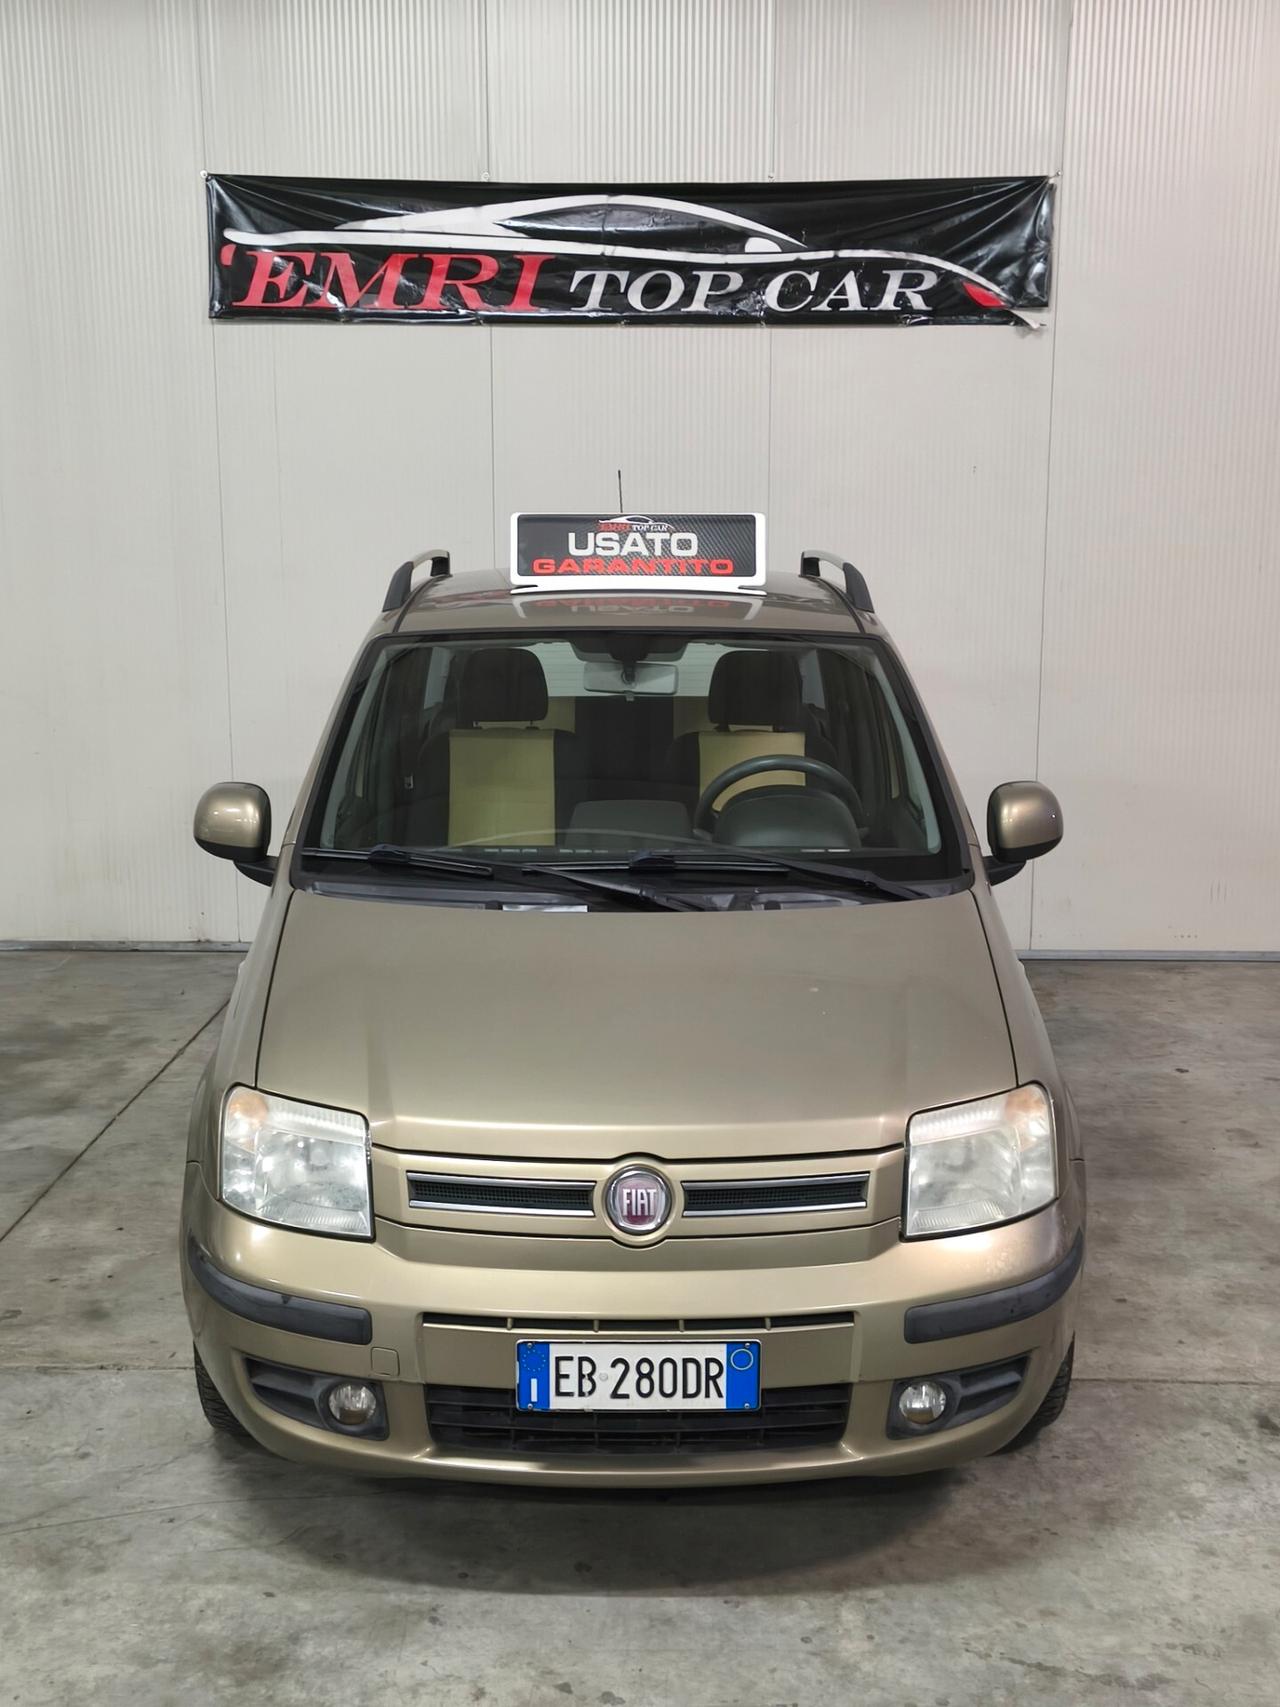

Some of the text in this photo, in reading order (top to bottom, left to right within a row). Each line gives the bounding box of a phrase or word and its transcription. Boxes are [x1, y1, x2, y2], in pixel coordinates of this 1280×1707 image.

[569, 269, 744, 312] TOP
[766, 269, 940, 312] CAR
[632, 523, 649, 532] TOP
[568, 532, 699, 557] USATO
[532, 558, 735, 576] GARANTITO
[622, 1188, 657, 1216] FIAT
[530, 1378, 538, 1402] I
[554, 1356, 725, 1400] EB 280DR
